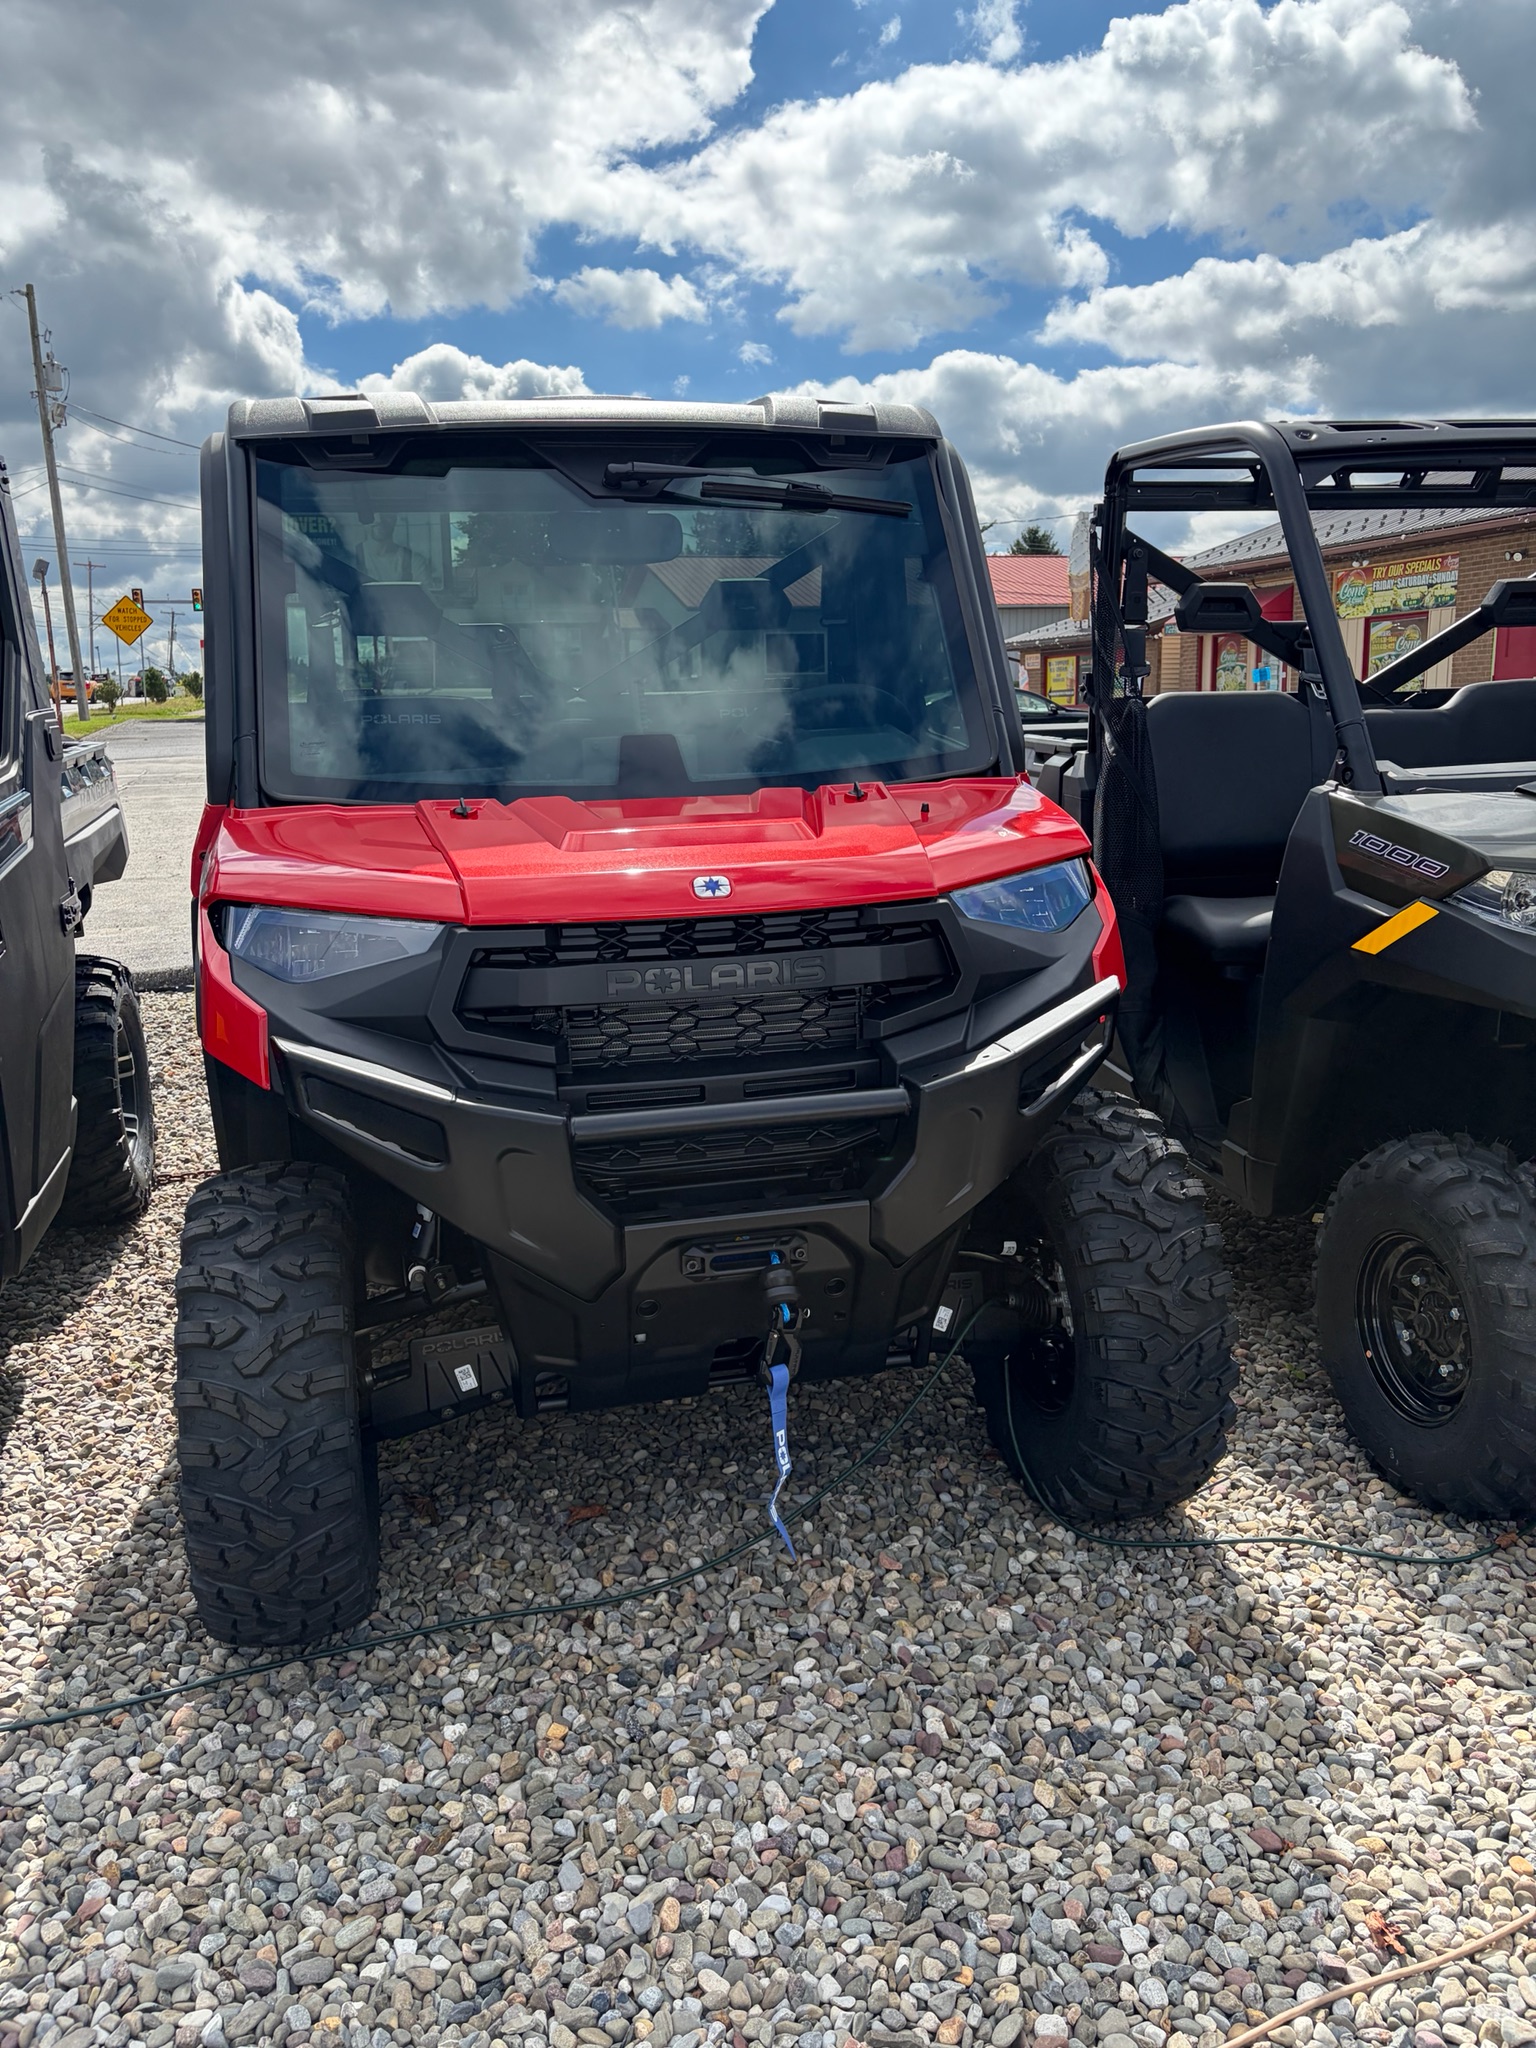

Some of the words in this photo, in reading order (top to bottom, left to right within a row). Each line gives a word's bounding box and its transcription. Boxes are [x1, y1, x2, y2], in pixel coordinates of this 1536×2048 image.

[1373, 566, 1388, 579] TRY
[1388, 563, 1405, 577] OUR
[1405, 558, 1442, 575] SPECIALS
[1372, 580, 1394, 592] FRIDAY
[1396, 574, 1430, 589] SATURDAY
[1432, 570, 1459, 584] SUNDAY
[361, 714, 442, 724] POLARIS
[1348, 829, 1450, 878] 1000
[606, 956, 826, 997] POLARIS
